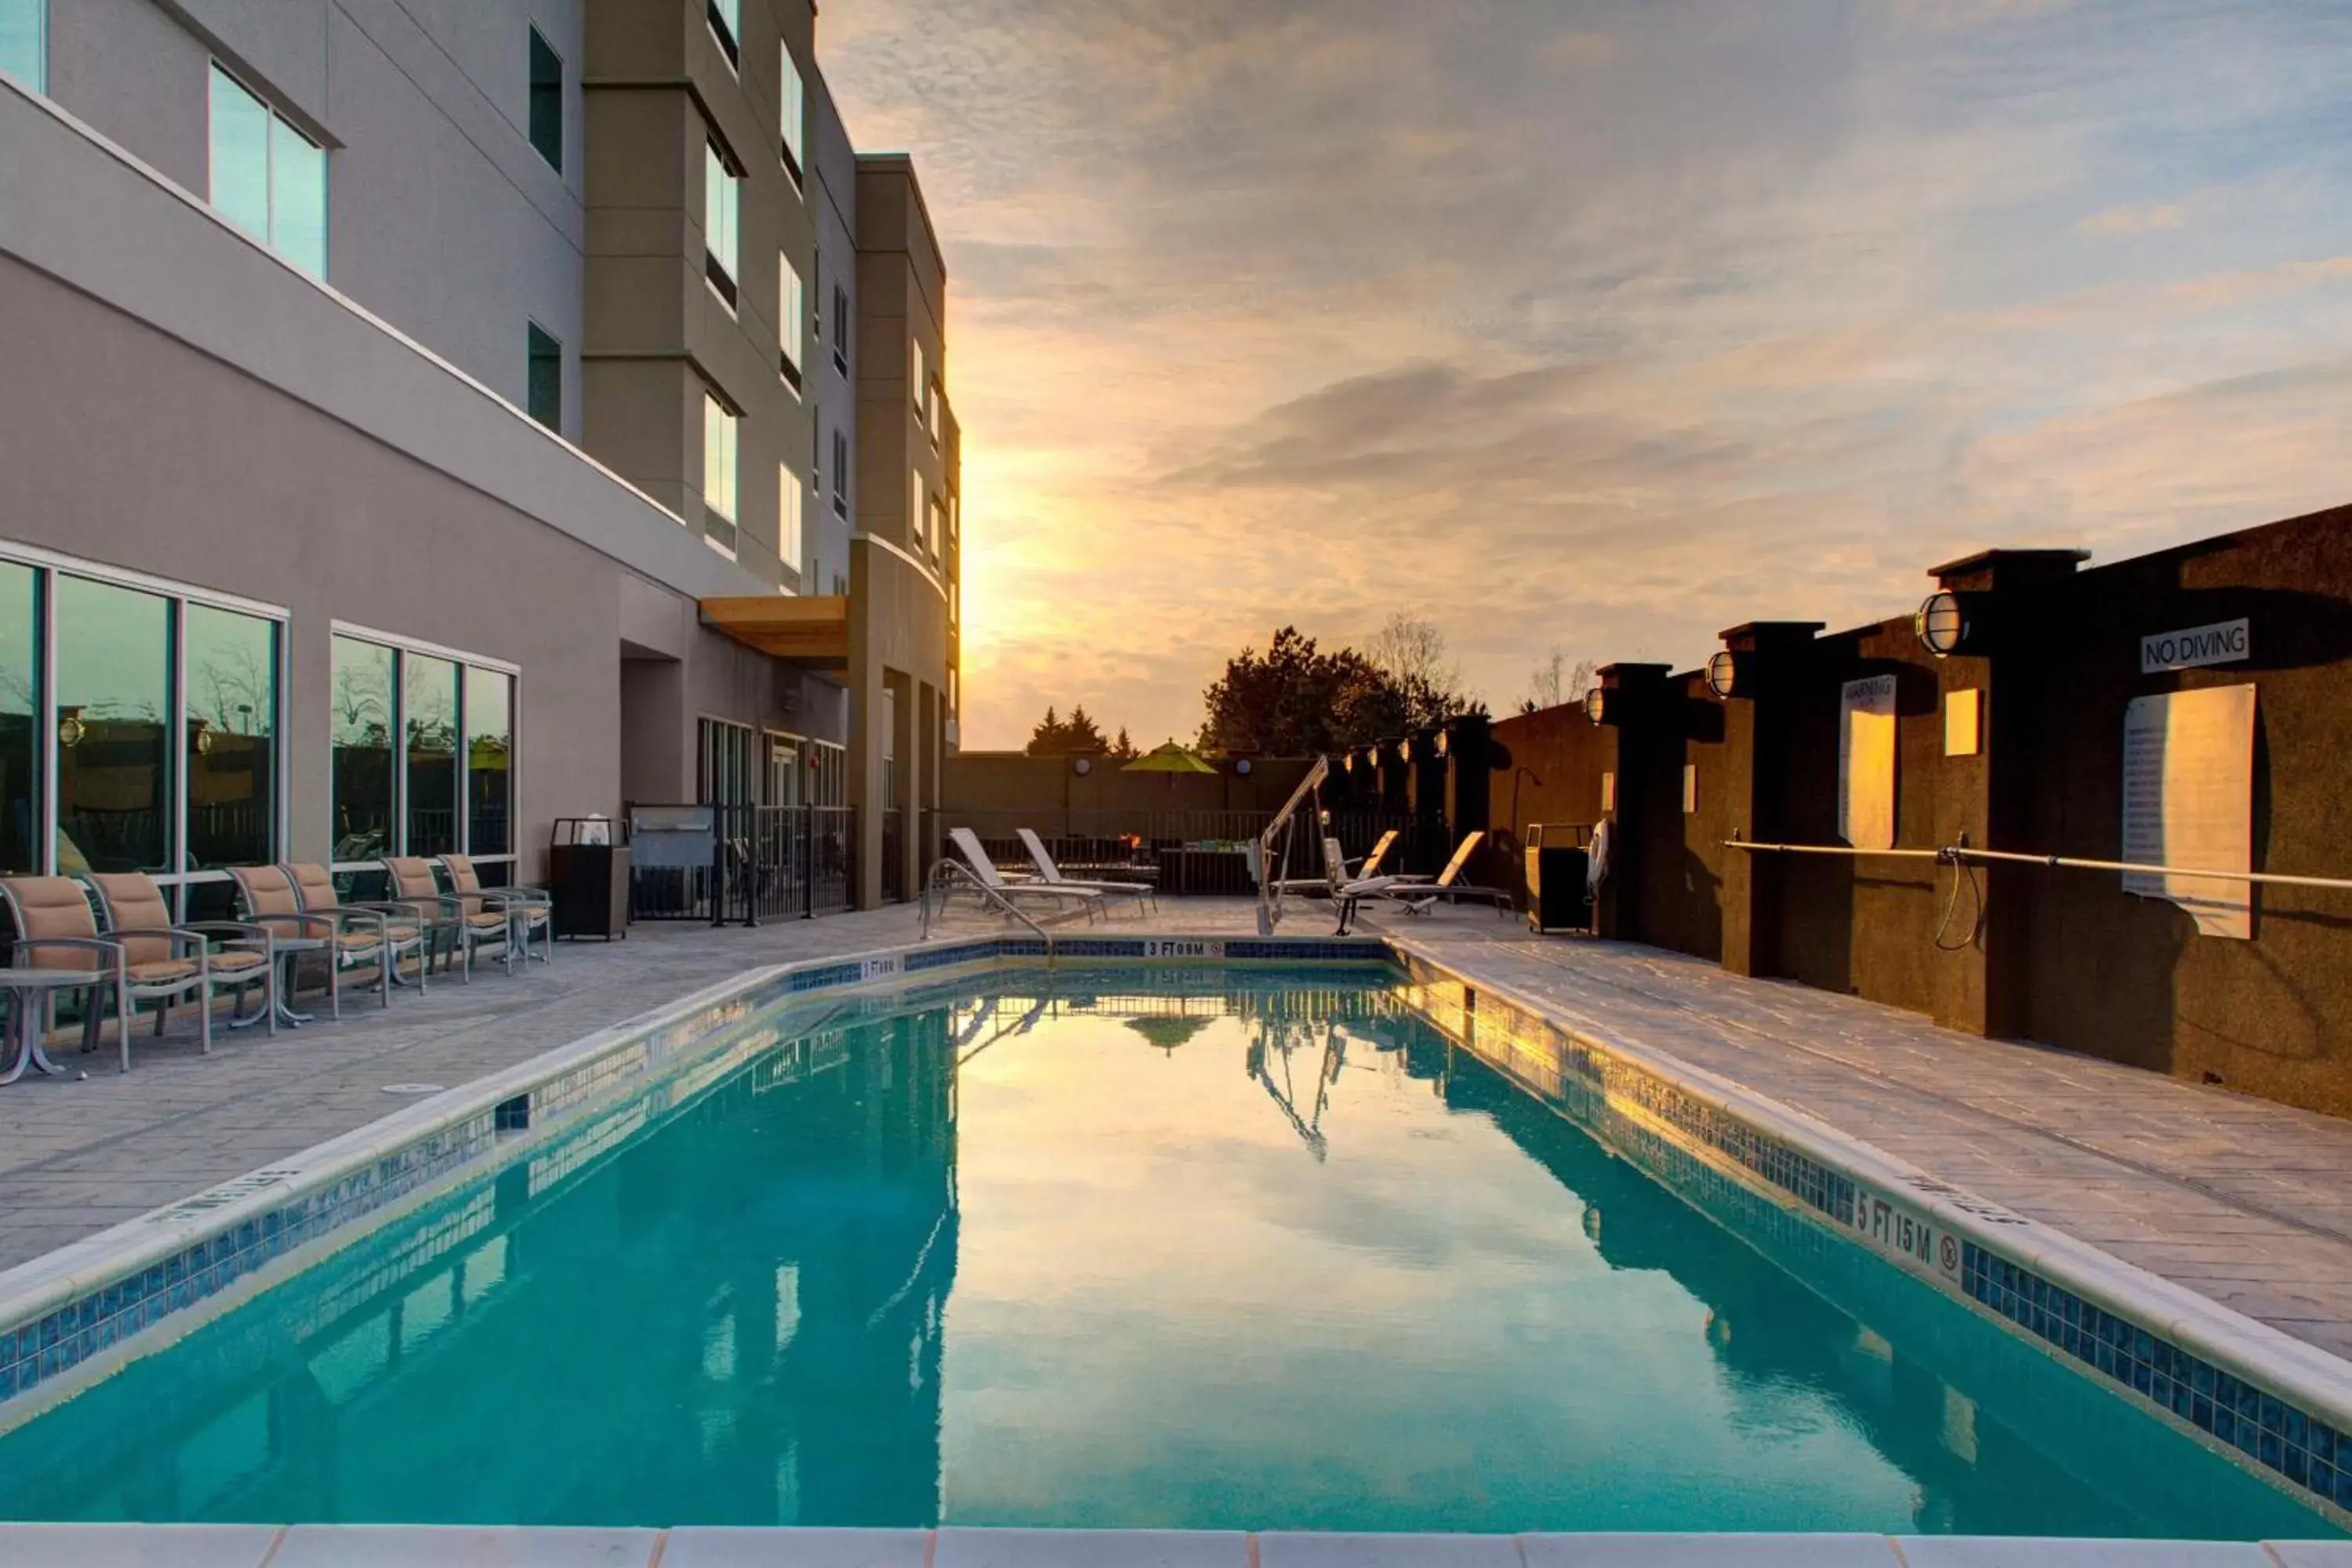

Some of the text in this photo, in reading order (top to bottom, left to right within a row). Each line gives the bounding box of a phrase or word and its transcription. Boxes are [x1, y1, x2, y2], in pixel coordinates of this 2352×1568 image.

[2146, 627, 2245, 665] NO DIVING
[1150, 942, 1156, 956] 3
[1162, 942, 1175, 956] FT
[1858, 1190, 1867, 1230] 5
[1874, 1199, 1892, 1245] FT
